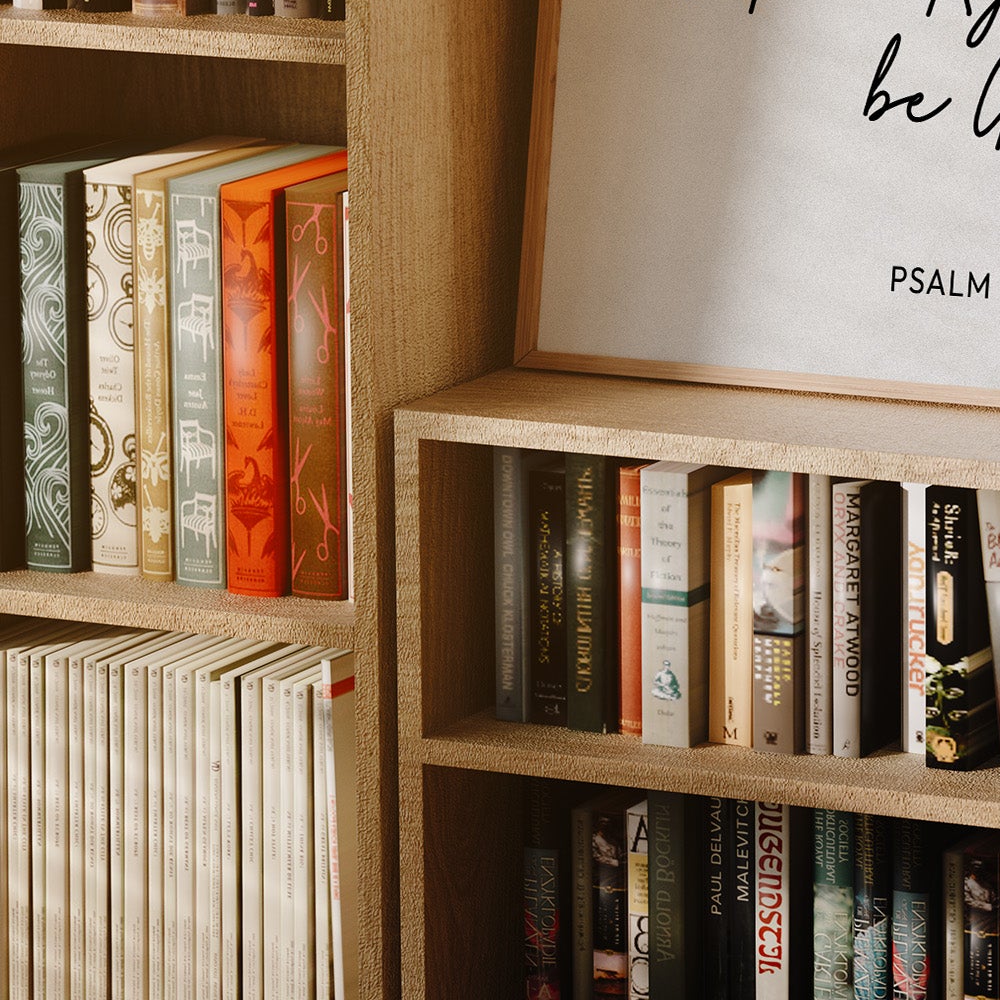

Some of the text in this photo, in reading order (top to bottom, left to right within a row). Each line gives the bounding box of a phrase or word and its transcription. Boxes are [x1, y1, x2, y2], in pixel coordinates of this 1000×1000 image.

[863, 33, 952, 122] be
[890, 265, 991, 299] PSALM
[833, 492, 846, 670] ORYX AND CRAKE
[846, 493, 861, 698] MARGARET ATWOOD
[710, 797, 722, 916] PAUL DELVAU
